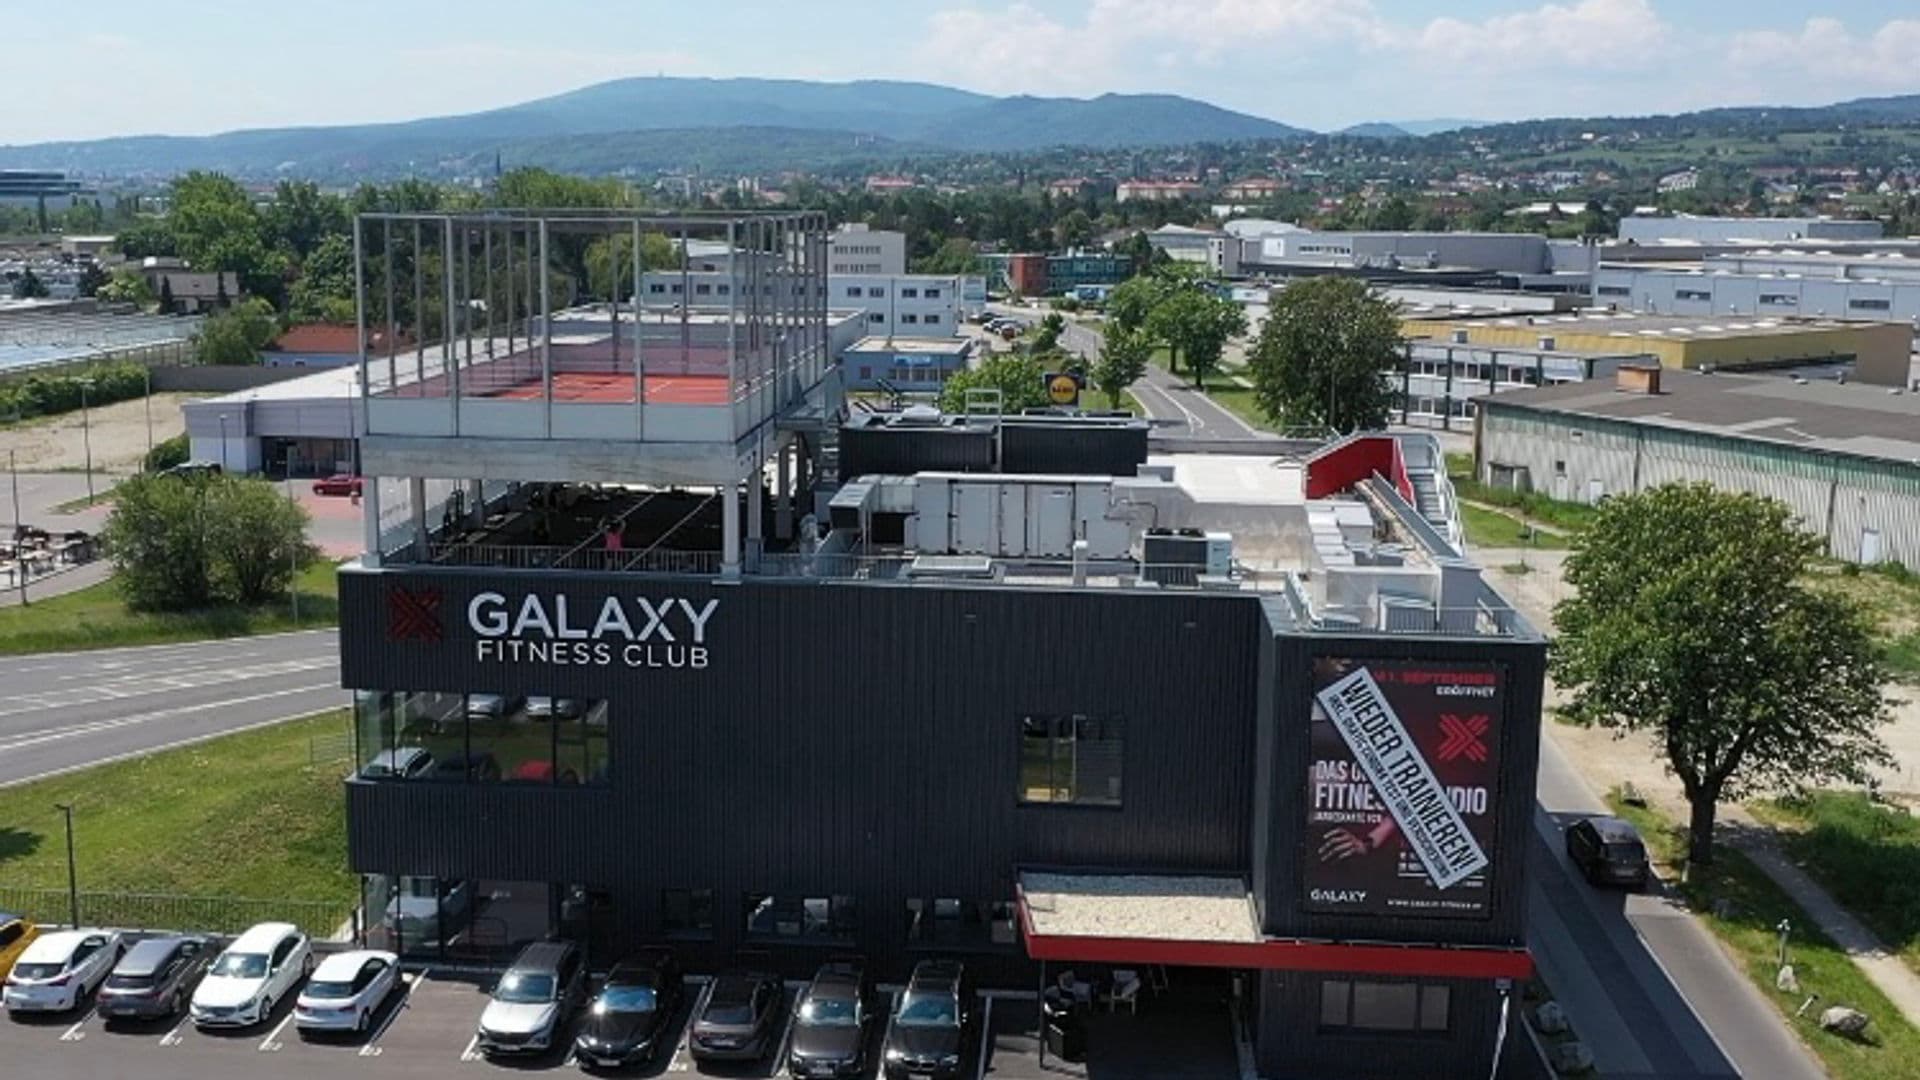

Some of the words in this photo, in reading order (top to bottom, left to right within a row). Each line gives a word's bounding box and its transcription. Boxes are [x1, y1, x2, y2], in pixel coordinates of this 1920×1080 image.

[468, 592, 720, 642] GALAXY
[478, 640, 611, 665] FITNESS
[623, 645, 709, 667] CLUB
[1435, 685, 1496, 697] ERÖFFNET
[1316, 760, 1348, 781] DAS
[1339, 676, 1403, 758] WIEDER
[1386, 750, 1478, 873] TRAINIEREN!
[1315, 783, 1386, 811] FITNE
[1310, 887, 1366, 902] GALAXY
